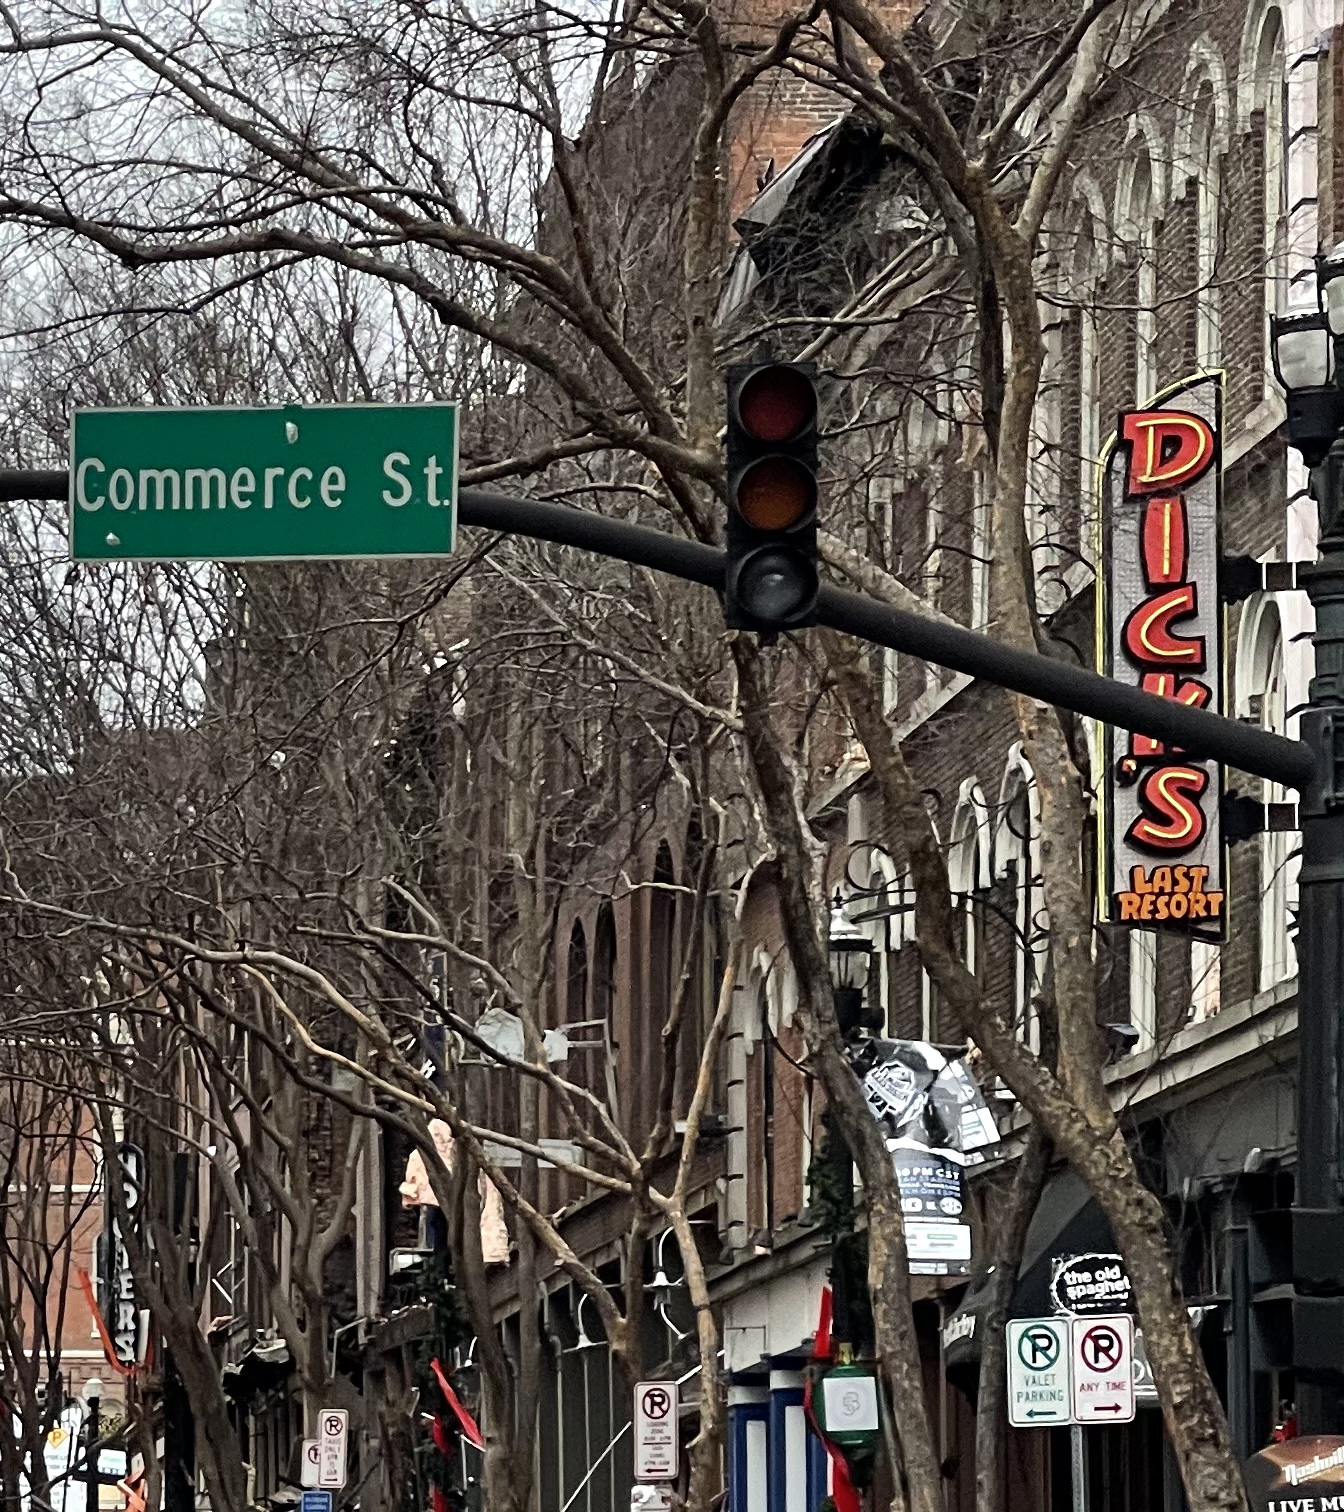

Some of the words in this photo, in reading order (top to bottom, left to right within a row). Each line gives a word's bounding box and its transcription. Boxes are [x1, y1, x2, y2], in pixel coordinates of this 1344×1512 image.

[76, 457, 346, 512] Commerce
[382, 452, 450, 507] St.
[1131, 865, 1208, 895] LAST
[1119, 892, 1224, 921] RESORT
[1064, 1271, 1092, 1286] the
[1094, 1265, 1121, 1281] old
[1023, 1373, 1056, 1387] VALET
[1079, 1382, 1100, 1392] ANY
[1106, 1381, 1127, 1391] TIME
[1016, 1390, 1064, 1403] PARKING
